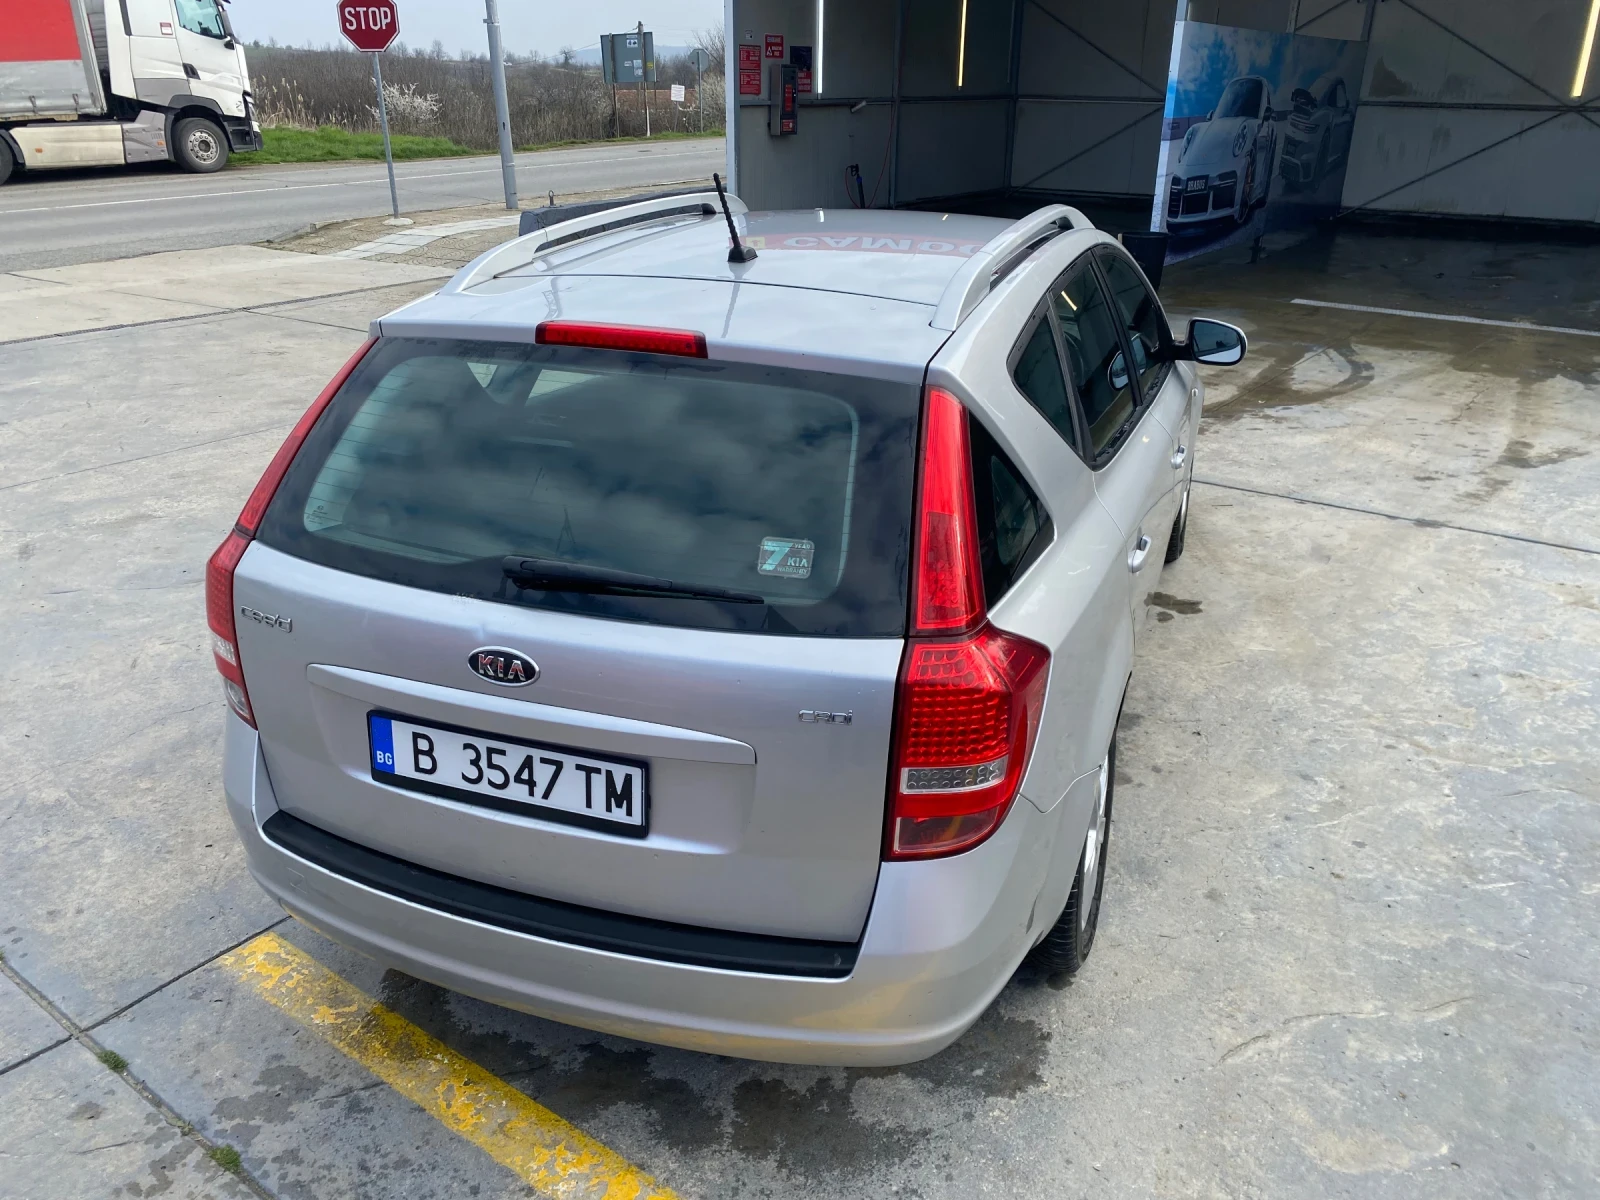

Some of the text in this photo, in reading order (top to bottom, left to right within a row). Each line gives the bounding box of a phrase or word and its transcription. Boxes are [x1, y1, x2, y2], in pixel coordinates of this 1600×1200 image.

[344, 7, 391, 30] STOP
[761, 541, 793, 571] 7
[787, 557, 808, 567] KIA
[478, 654, 526, 681] KIA
[376, 750, 393, 766] BG
[411, 731, 633, 817] B 3547 TM
